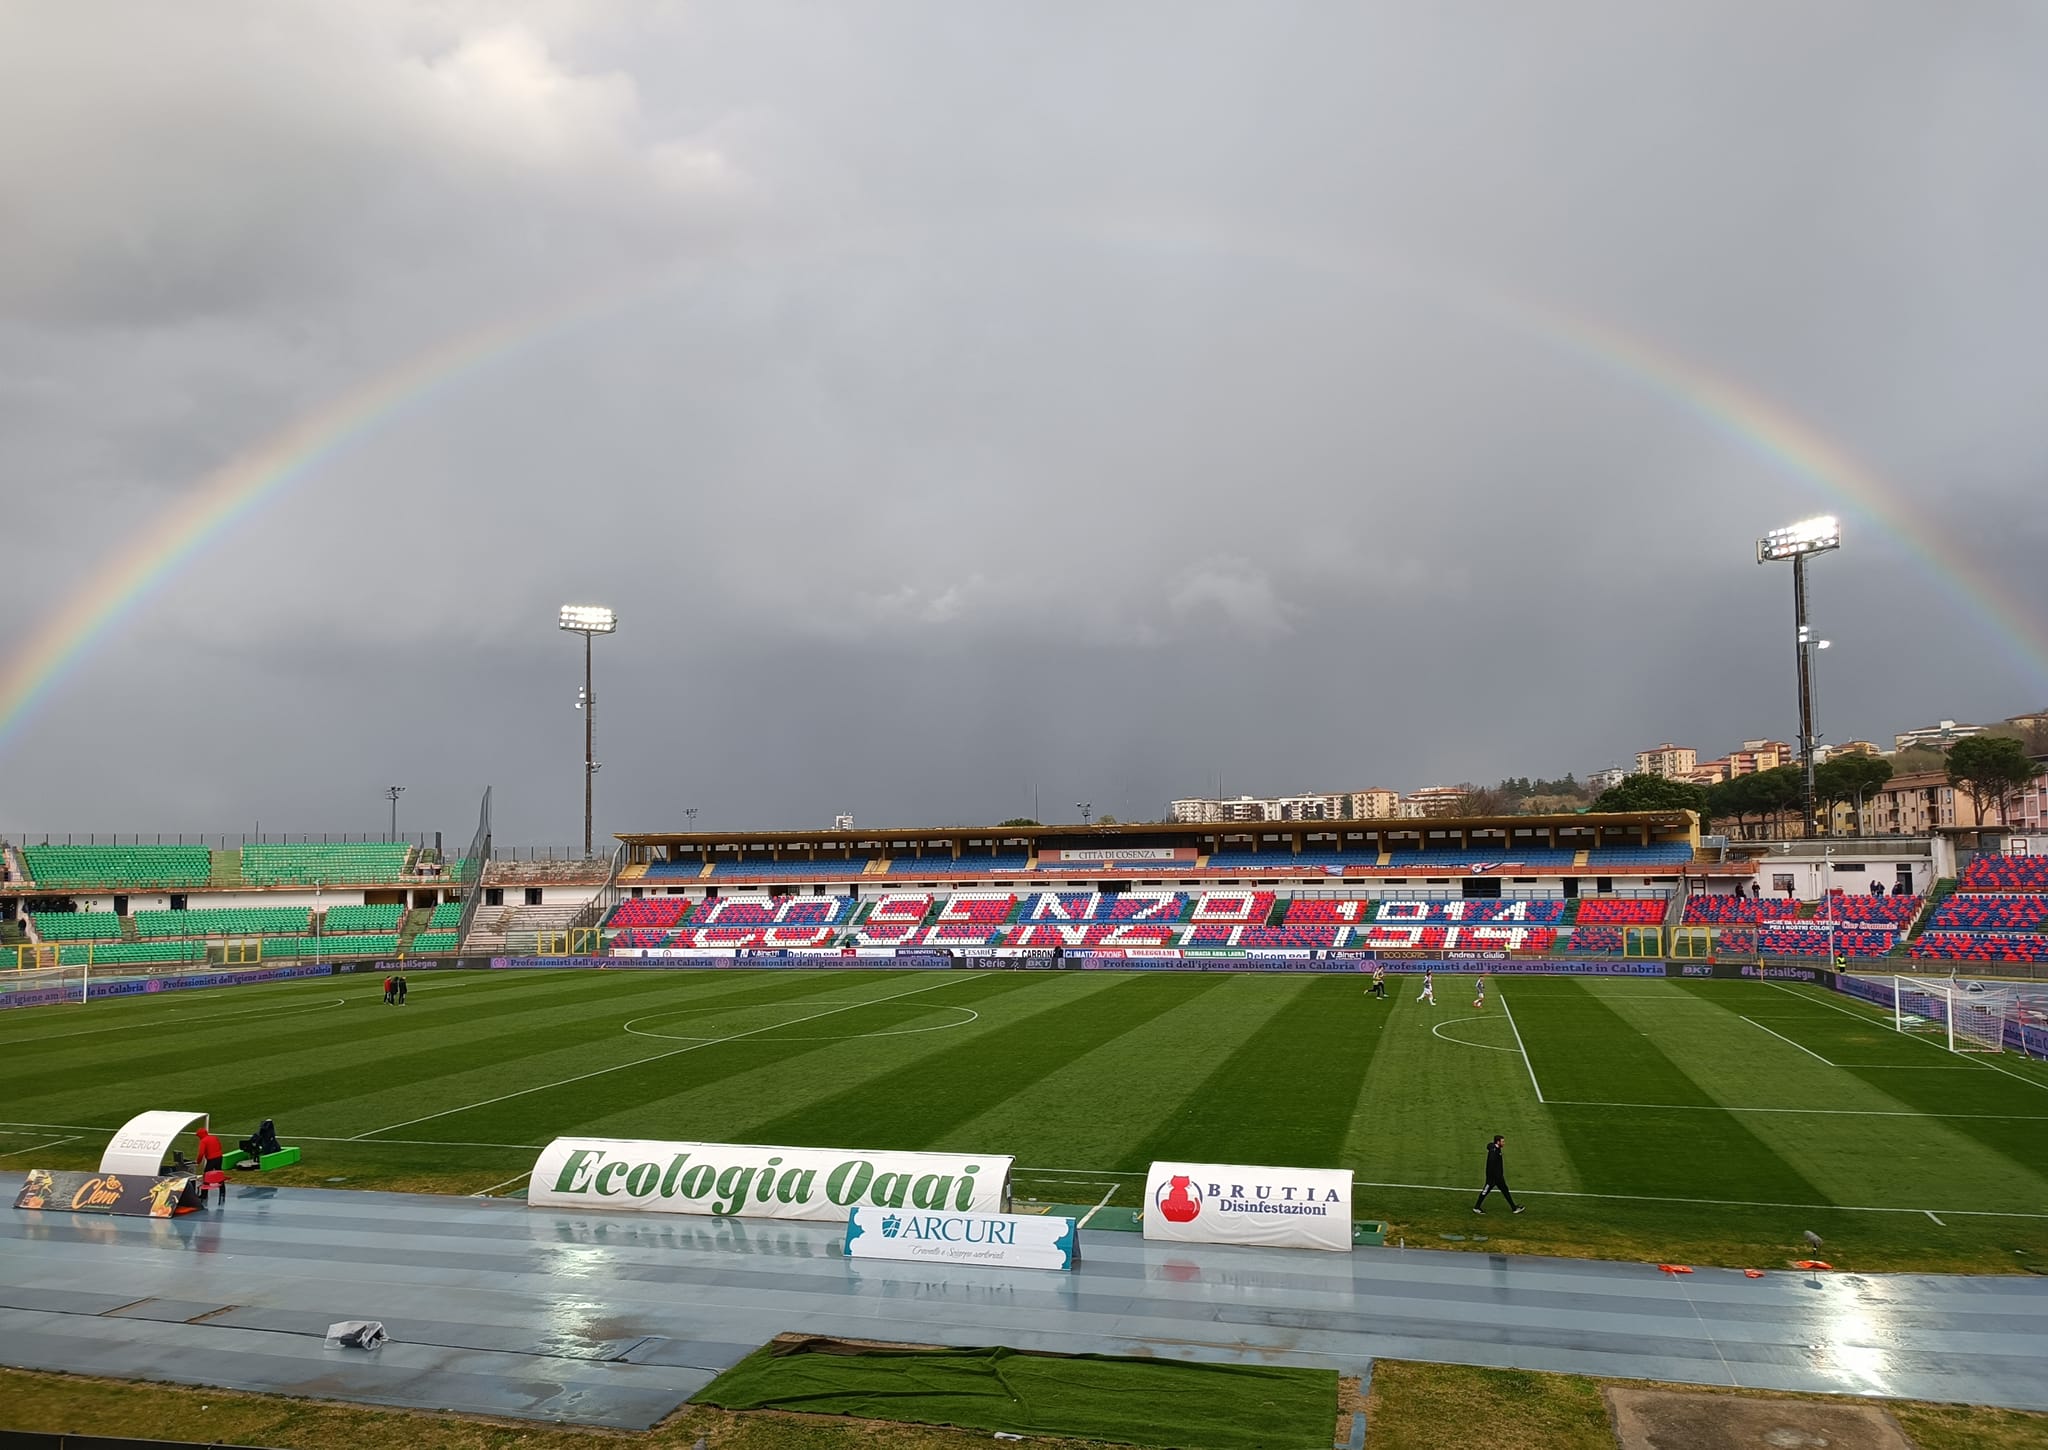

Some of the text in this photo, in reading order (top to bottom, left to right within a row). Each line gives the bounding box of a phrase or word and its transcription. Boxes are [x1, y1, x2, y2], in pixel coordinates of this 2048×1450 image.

[1079, 849, 1104, 859] CITTÀ
[1116, 850, 1156, 859] COSENZA
[692, 891, 1529, 949] COSENZA 1914
[1483, 951, 1505, 959] Giulio
[510, 959, 571, 967] Professionisti
[618, 959, 664, 967] ambientale
[678, 959, 712, 967] Calabria
[733, 959, 794, 968] Professionisti
[796, 958, 843, 969] dell'igiene
[845, 959, 896, 967] ambientale
[911, 959, 950, 967] Calabria
[979, 959, 1051, 968] Serie BKT
[1104, 959, 1173, 968] Professionisti
[1176, 960, 1230, 970] dell'igiene
[1232, 961, 1292, 970] ambientale
[1309, 962, 1355, 970] Calabria
[1382, 961, 1664, 974] Professionisti dell'igiene ambientale in Calabria
[1683, 965, 1712, 975] BKT
[163, 976, 217, 989] Professionisti
[219, 973, 256, 985] dell'igiene
[258, 969, 296, 981] ambientale
[305, 965, 331, 975] Calabria
[108, 983, 144, 995] Calabria
[550, 1149, 817, 1216] Ecologia
[1207, 1183, 1340, 1202] BRUTIA
[1220, 1199, 1327, 1216] Disinfestazioni
[900, 1216, 1018, 1245] ARCURI
